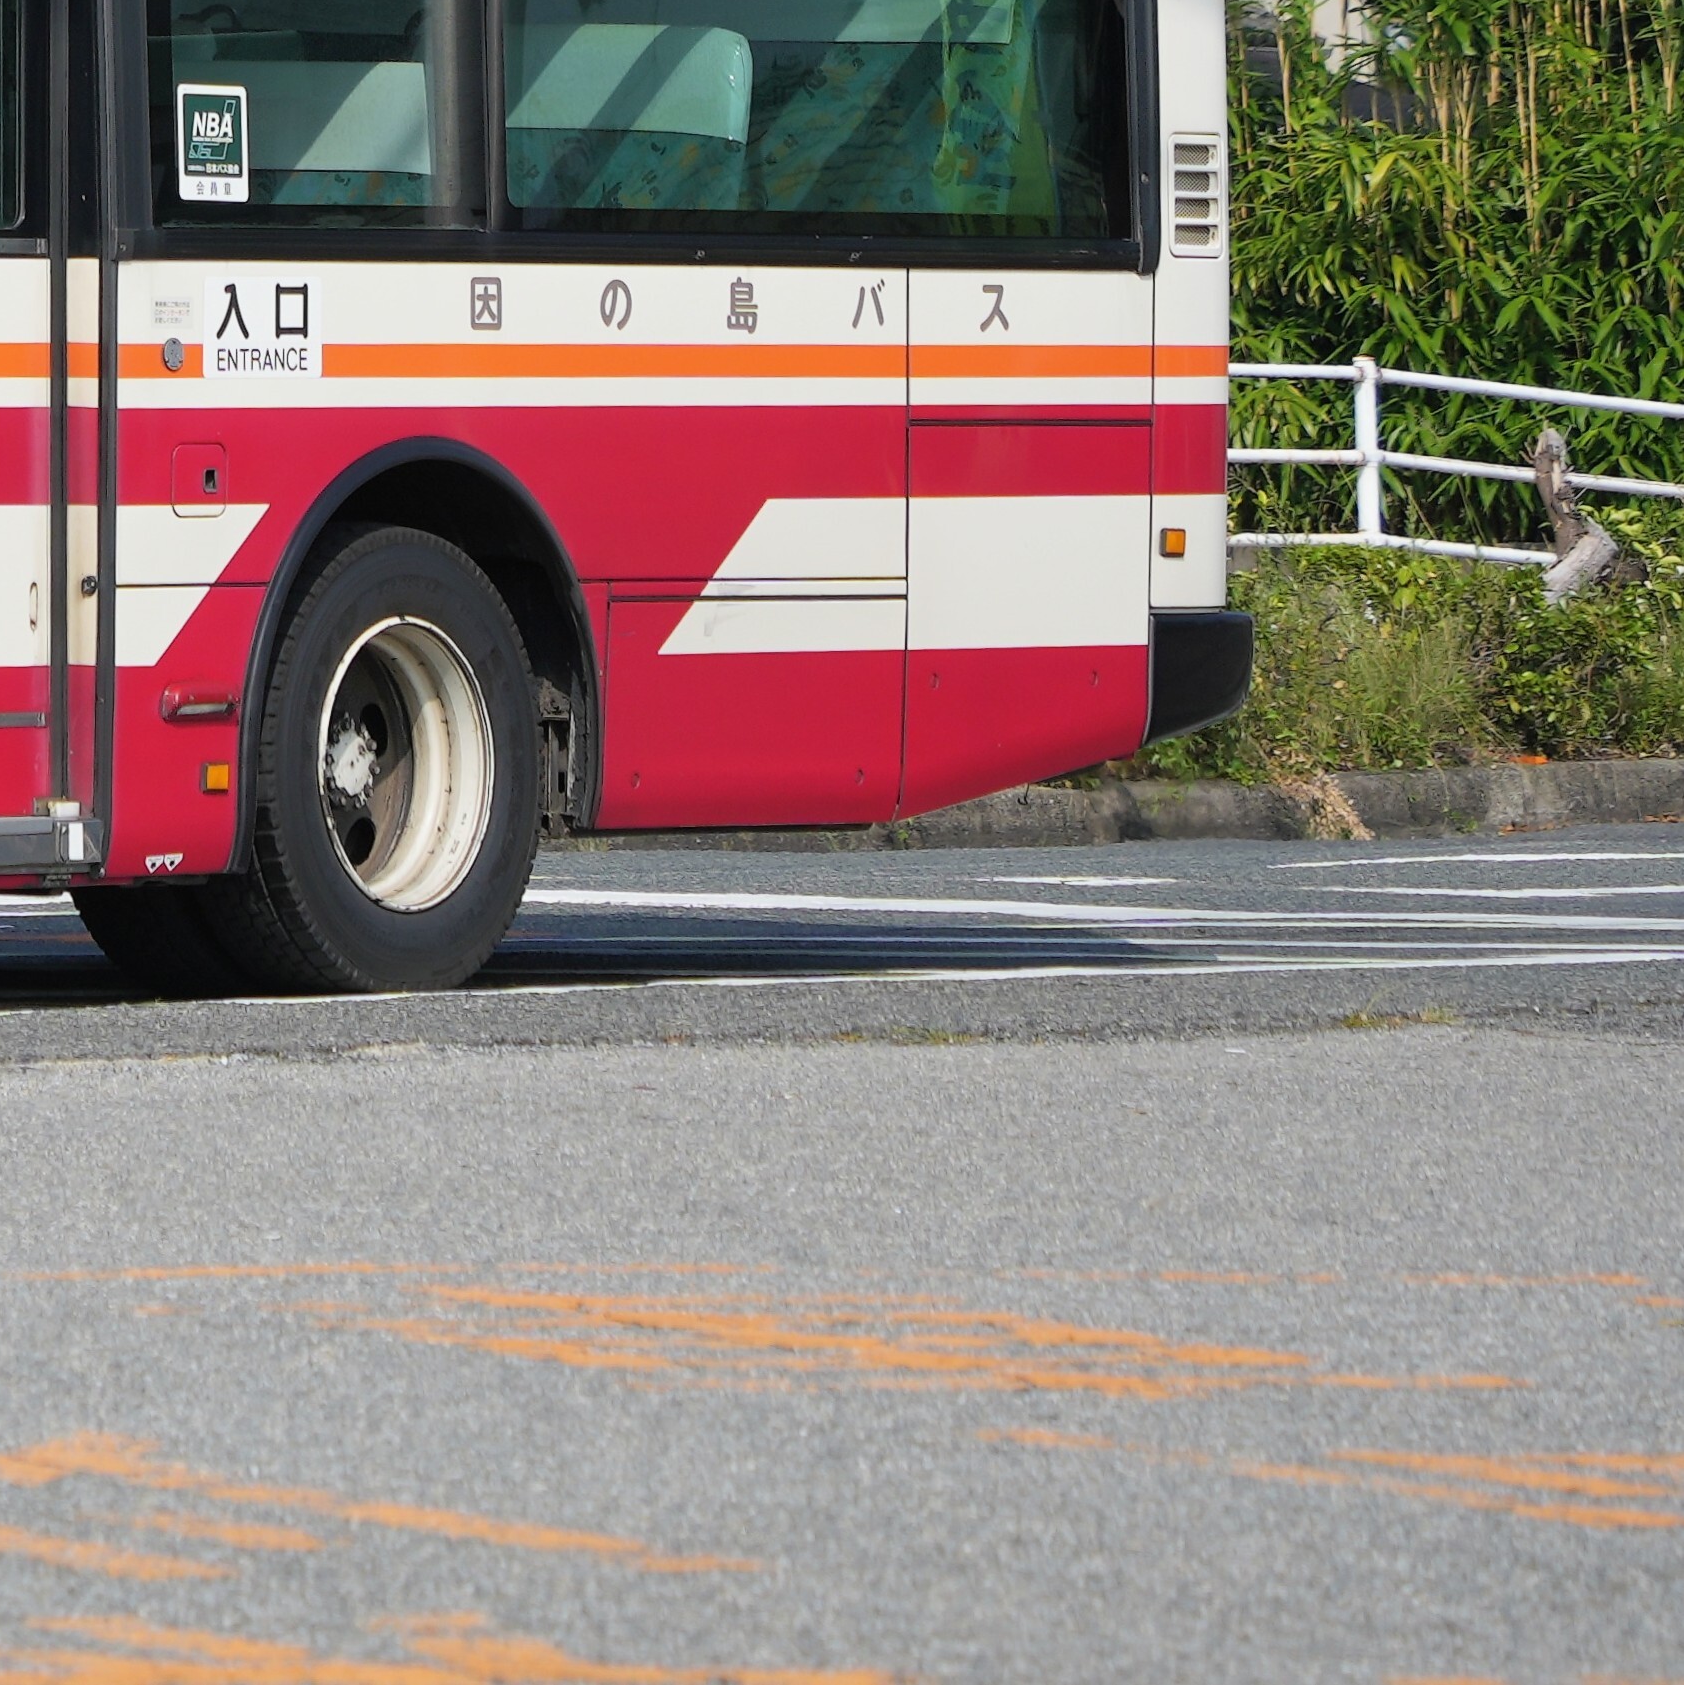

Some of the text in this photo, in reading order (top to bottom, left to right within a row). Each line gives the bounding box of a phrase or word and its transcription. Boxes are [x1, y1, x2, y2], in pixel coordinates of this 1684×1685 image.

[191, 111, 234, 138] NBA
[215, 282, 309, 340] 入口
[470, 275, 1011, 334] 因の島バス
[217, 347, 308, 372] ENTRANCE
